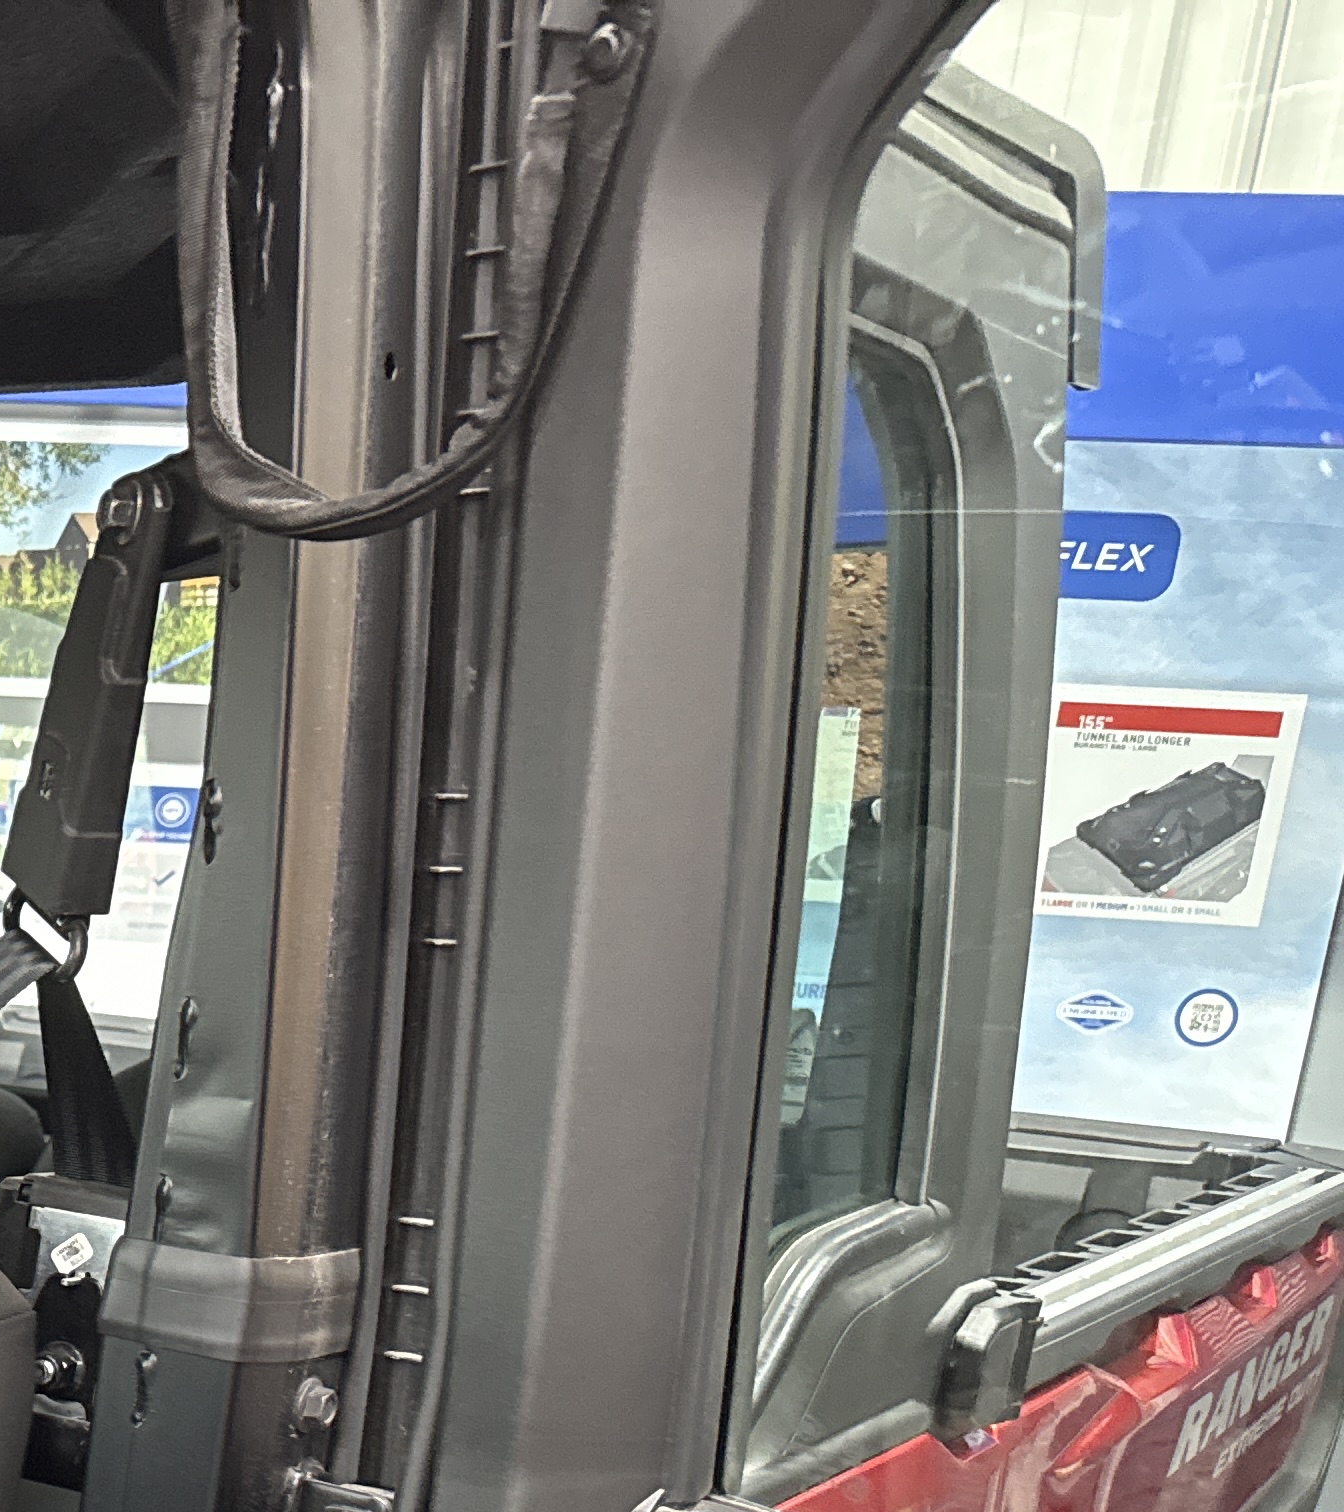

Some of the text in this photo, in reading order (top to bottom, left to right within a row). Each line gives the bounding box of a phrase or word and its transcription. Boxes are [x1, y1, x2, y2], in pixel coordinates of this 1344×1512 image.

[1076, 731, 1192, 746] TUNNEL AND LONGER
[1166, 1294, 1335, 1478] RANGER
